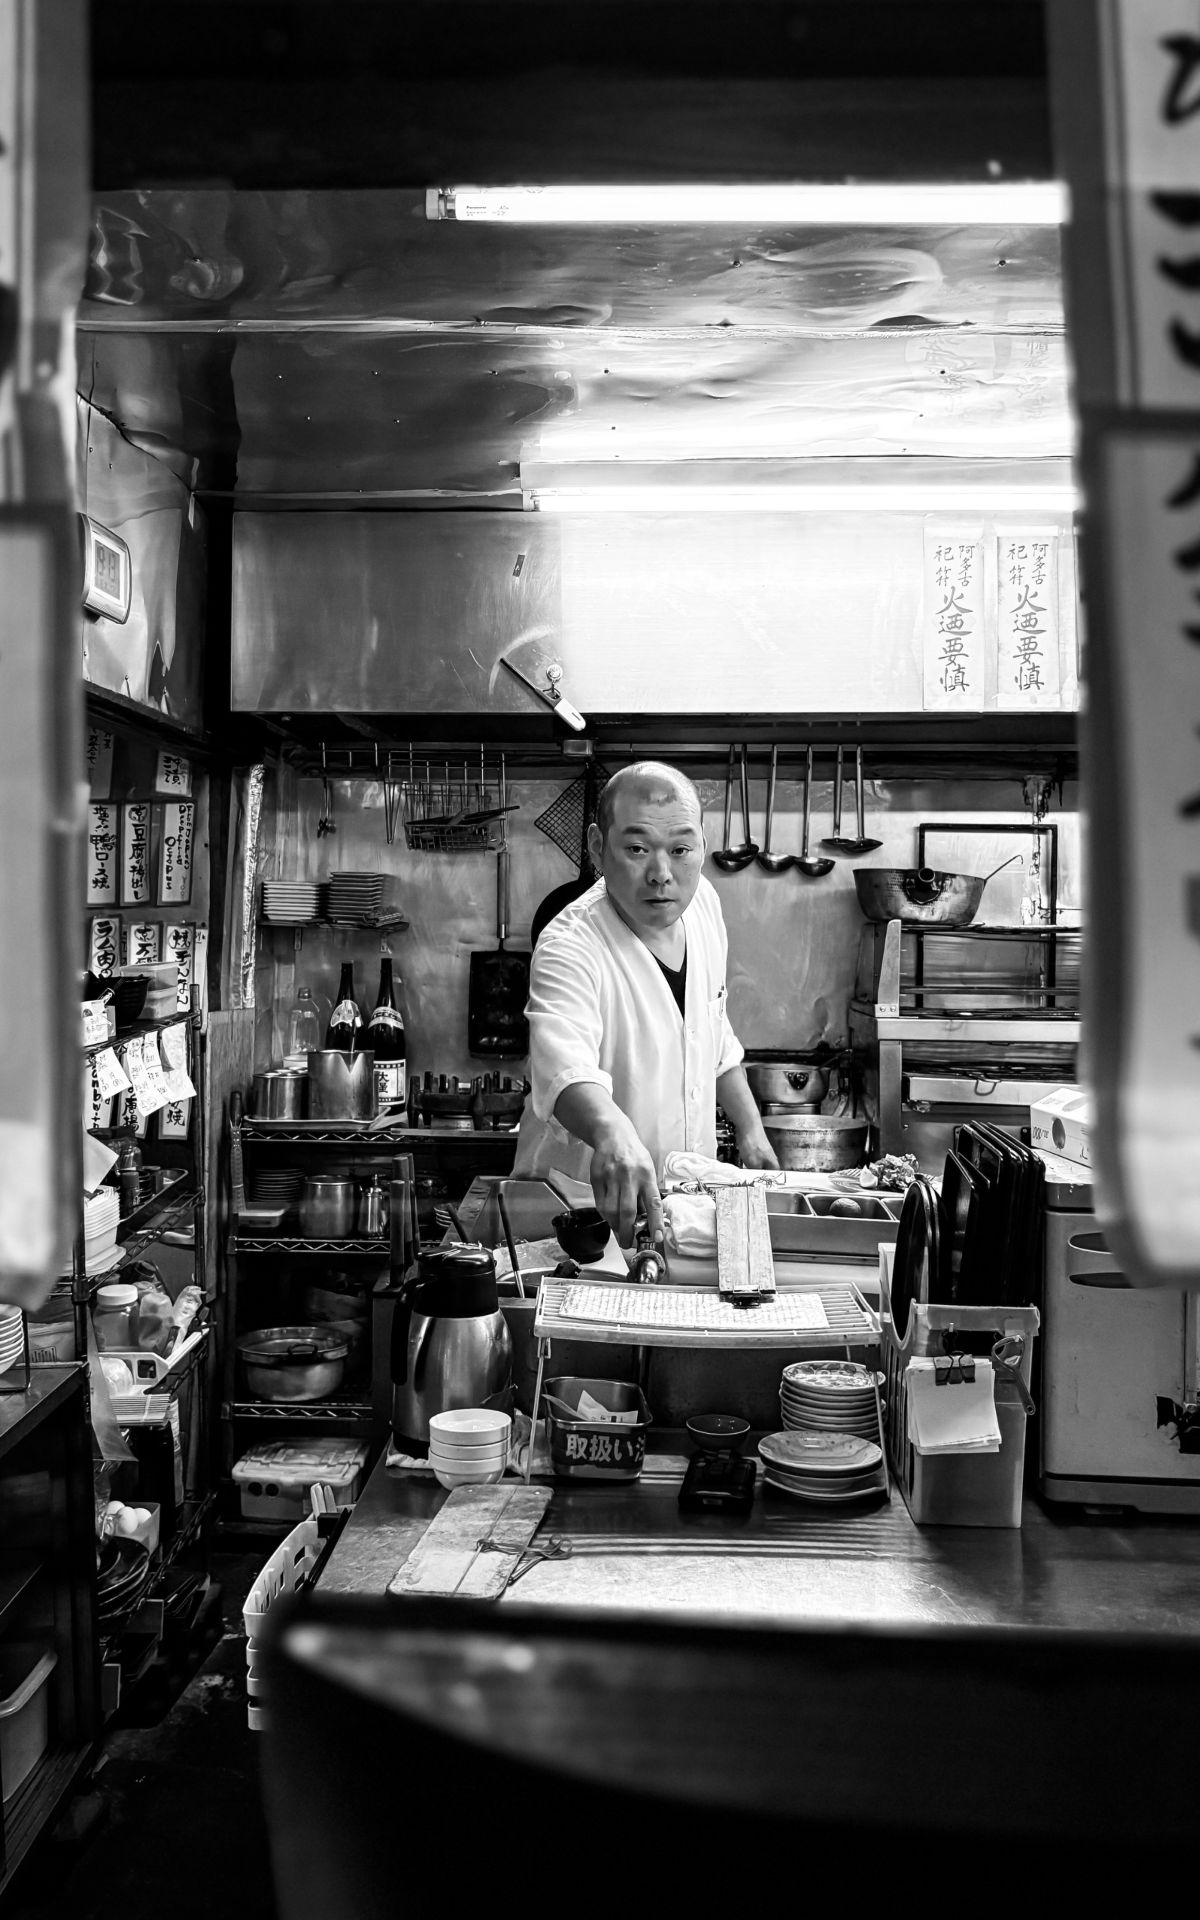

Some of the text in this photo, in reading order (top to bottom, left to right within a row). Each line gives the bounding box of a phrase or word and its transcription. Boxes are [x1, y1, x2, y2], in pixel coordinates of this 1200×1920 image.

[957, 544, 976, 587] 阿多古
[1031, 543, 1049, 586] 阿多古
